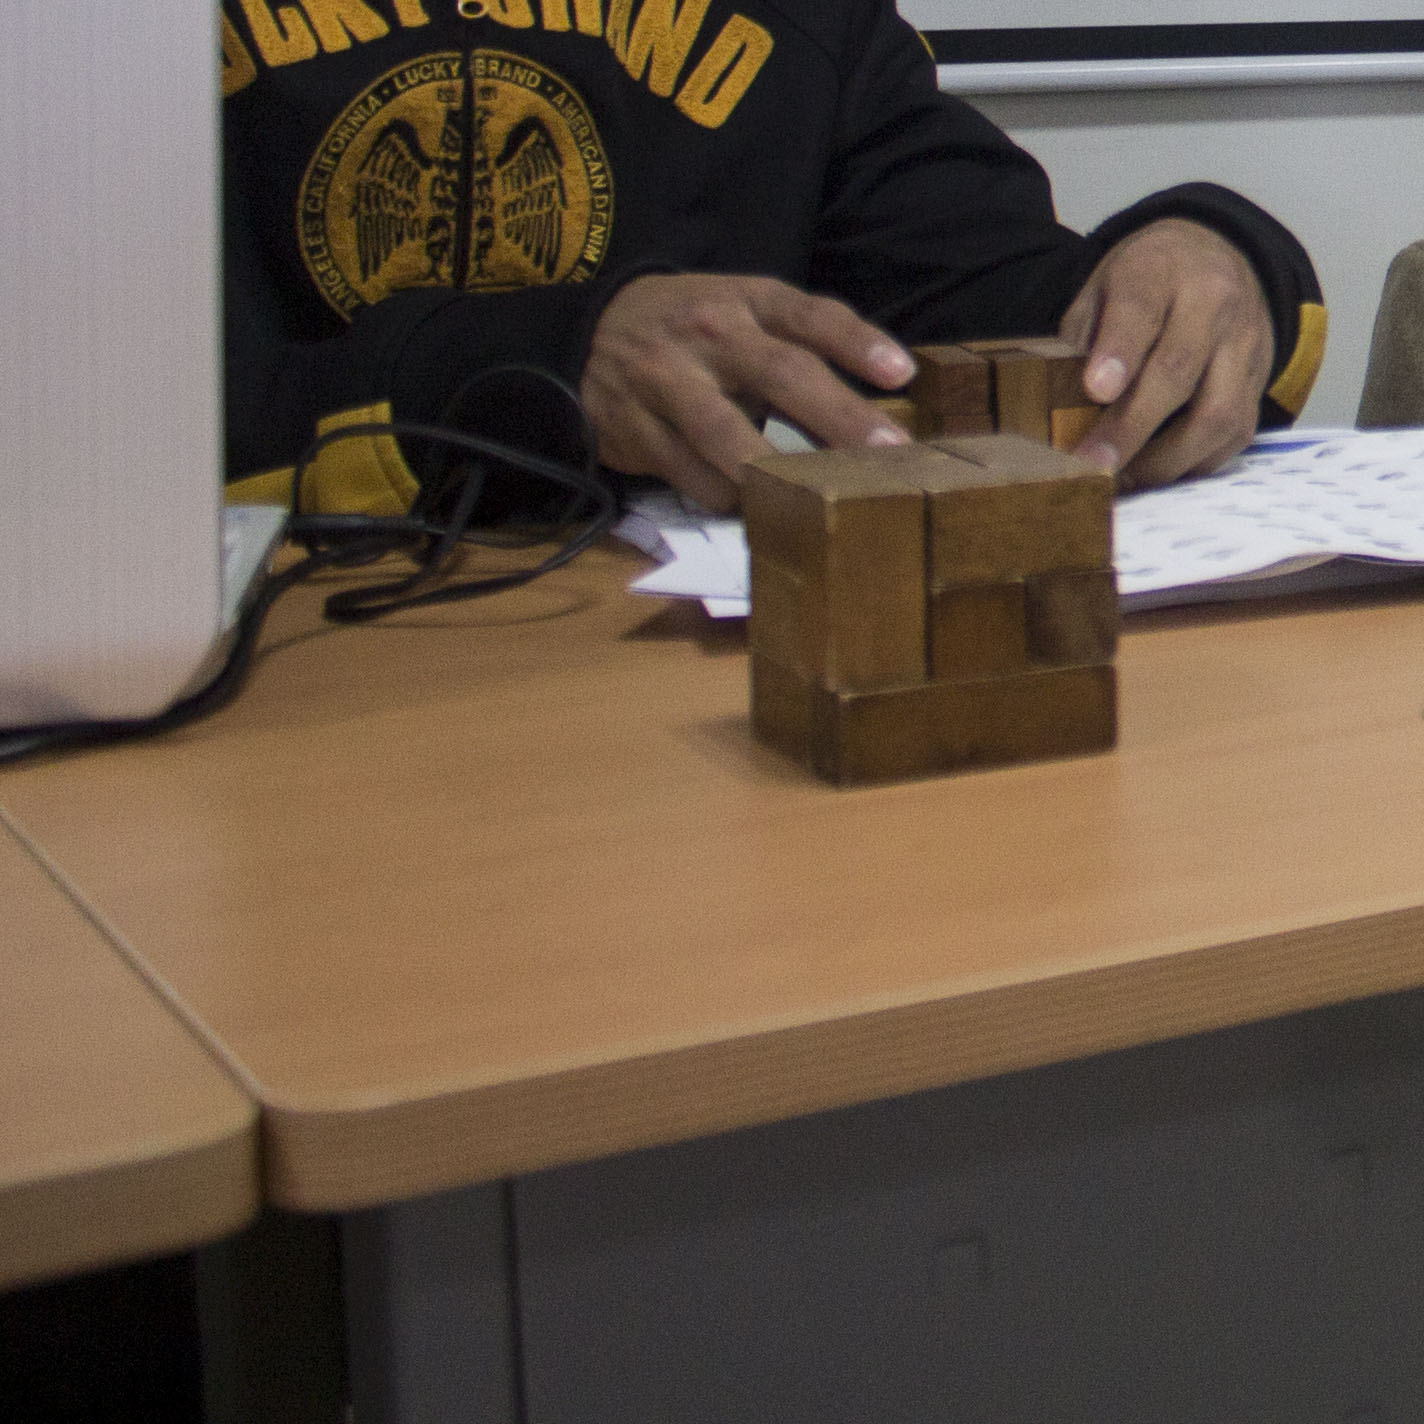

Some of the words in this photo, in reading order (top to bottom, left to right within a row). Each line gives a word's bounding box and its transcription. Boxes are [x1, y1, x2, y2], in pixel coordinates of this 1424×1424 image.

[305, 94, 384, 214] CALIFORNIA
[393, 61, 461, 90] LUCKY
[474, 58, 542, 89] BRAND
[552, 91, 607, 189] AMERICAN
[583, 193, 611, 264] DENIM
